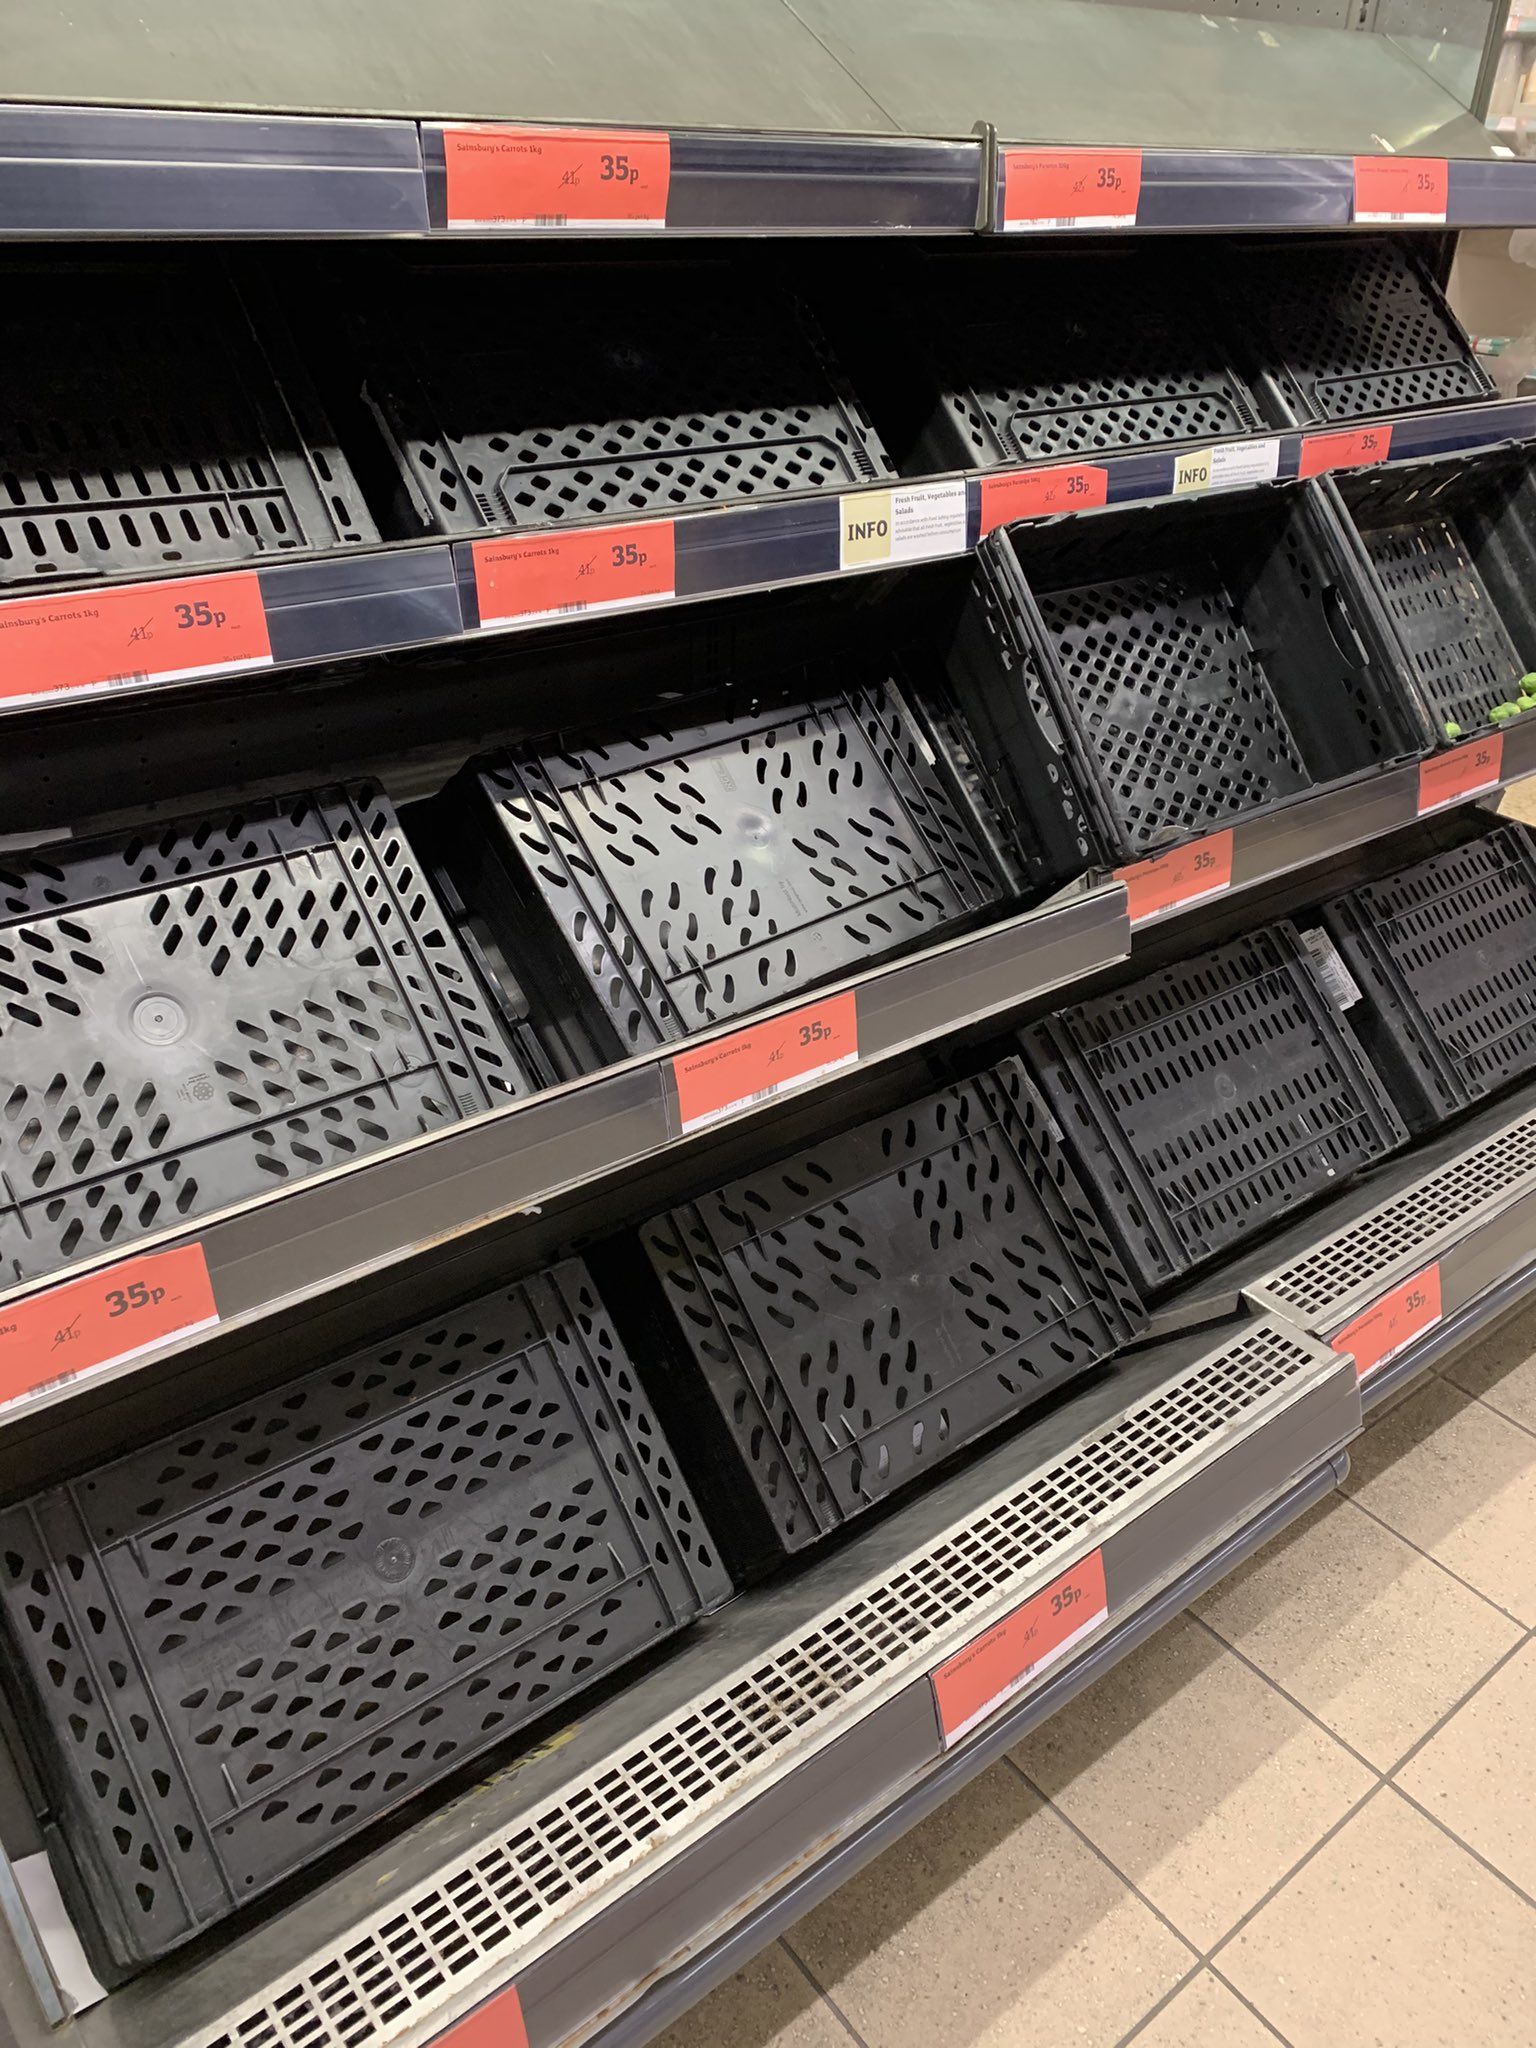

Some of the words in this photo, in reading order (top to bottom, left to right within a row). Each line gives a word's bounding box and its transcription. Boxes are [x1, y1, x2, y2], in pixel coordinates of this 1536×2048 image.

[456, 143, 500, 154] Sainsbury's
[501, 144, 528, 153] Carrots
[530, 144, 542, 155] 1kg
[600, 154, 639, 186] 35p
[1096, 167, 1122, 191] 35p
[1417, 173, 1435, 193] 35p
[1361, 434, 1378, 450] 35p
[1066, 475, 1090, 494] 35p
[1178, 466, 1207, 485] INFO
[927, 490, 957, 501] Vegetables
[895, 506, 914, 515] Salads
[847, 519, 888, 541] INFO
[483, 552, 522, 563] Sainsbury's
[523, 549, 547, 558] Carrots
[548, 547, 560, 556] 1kg
[611, 543, 648, 567] 35p
[0, 615, 47, 630] ainsbury's
[48, 611, 82, 622] Carrots
[83, 608, 100, 619] 1kg
[174, 601, 226, 629] 35p
[1475, 750, 1491, 767] 35p
[1194, 851, 1216, 871] 35p
[799, 1020, 832, 1047] 35p
[719, 1047, 741, 1059] Carrots
[105, 1281, 166, 1318] 35p
[1406, 1290, 1426, 1313] 35p
[1051, 1584, 1082, 1617] 35p
